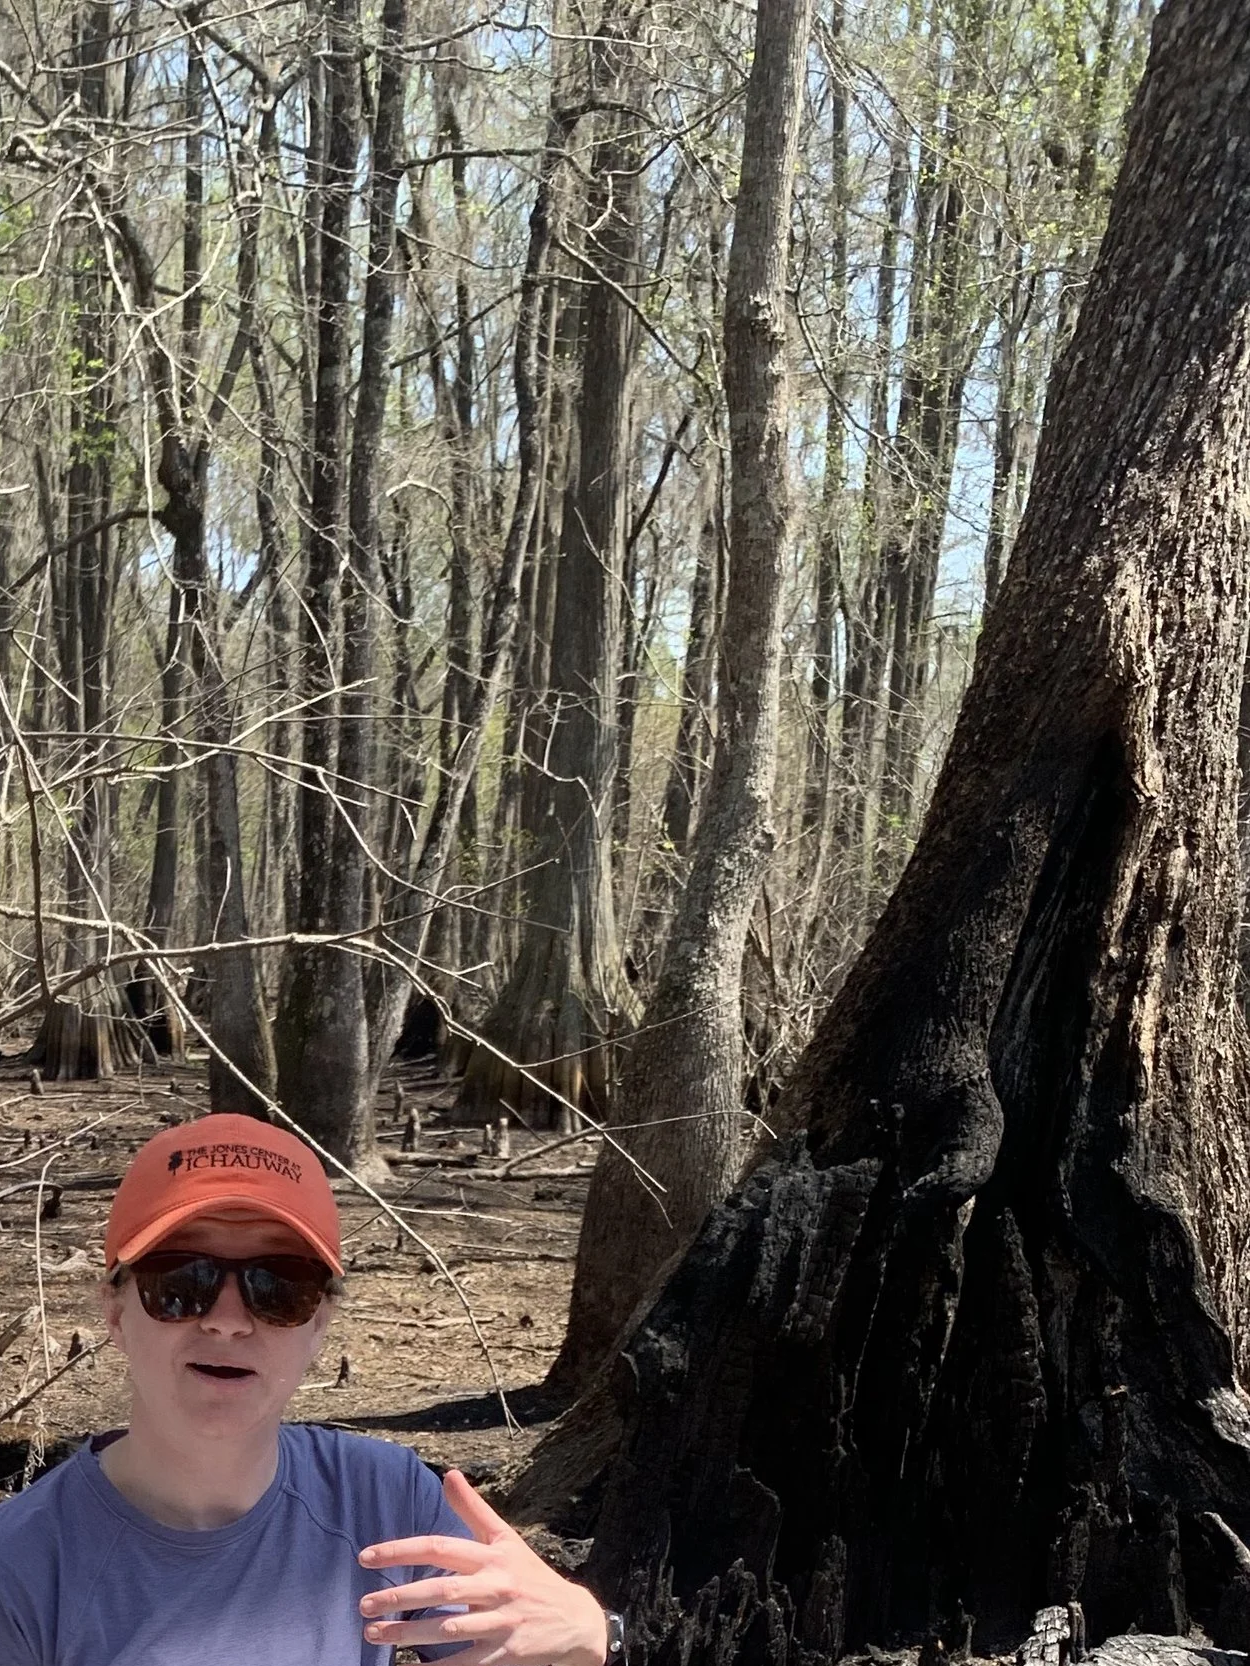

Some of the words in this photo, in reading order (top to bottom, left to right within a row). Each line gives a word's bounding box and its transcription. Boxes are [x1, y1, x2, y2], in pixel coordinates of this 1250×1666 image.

[186, 1154, 302, 1184] ICHAUWAY
[188, 1146, 207, 1156] THE
[211, 1145, 248, 1154] JONES
[250, 1147, 290, 1164] CENTER
[291, 1162, 302, 1171] AT
